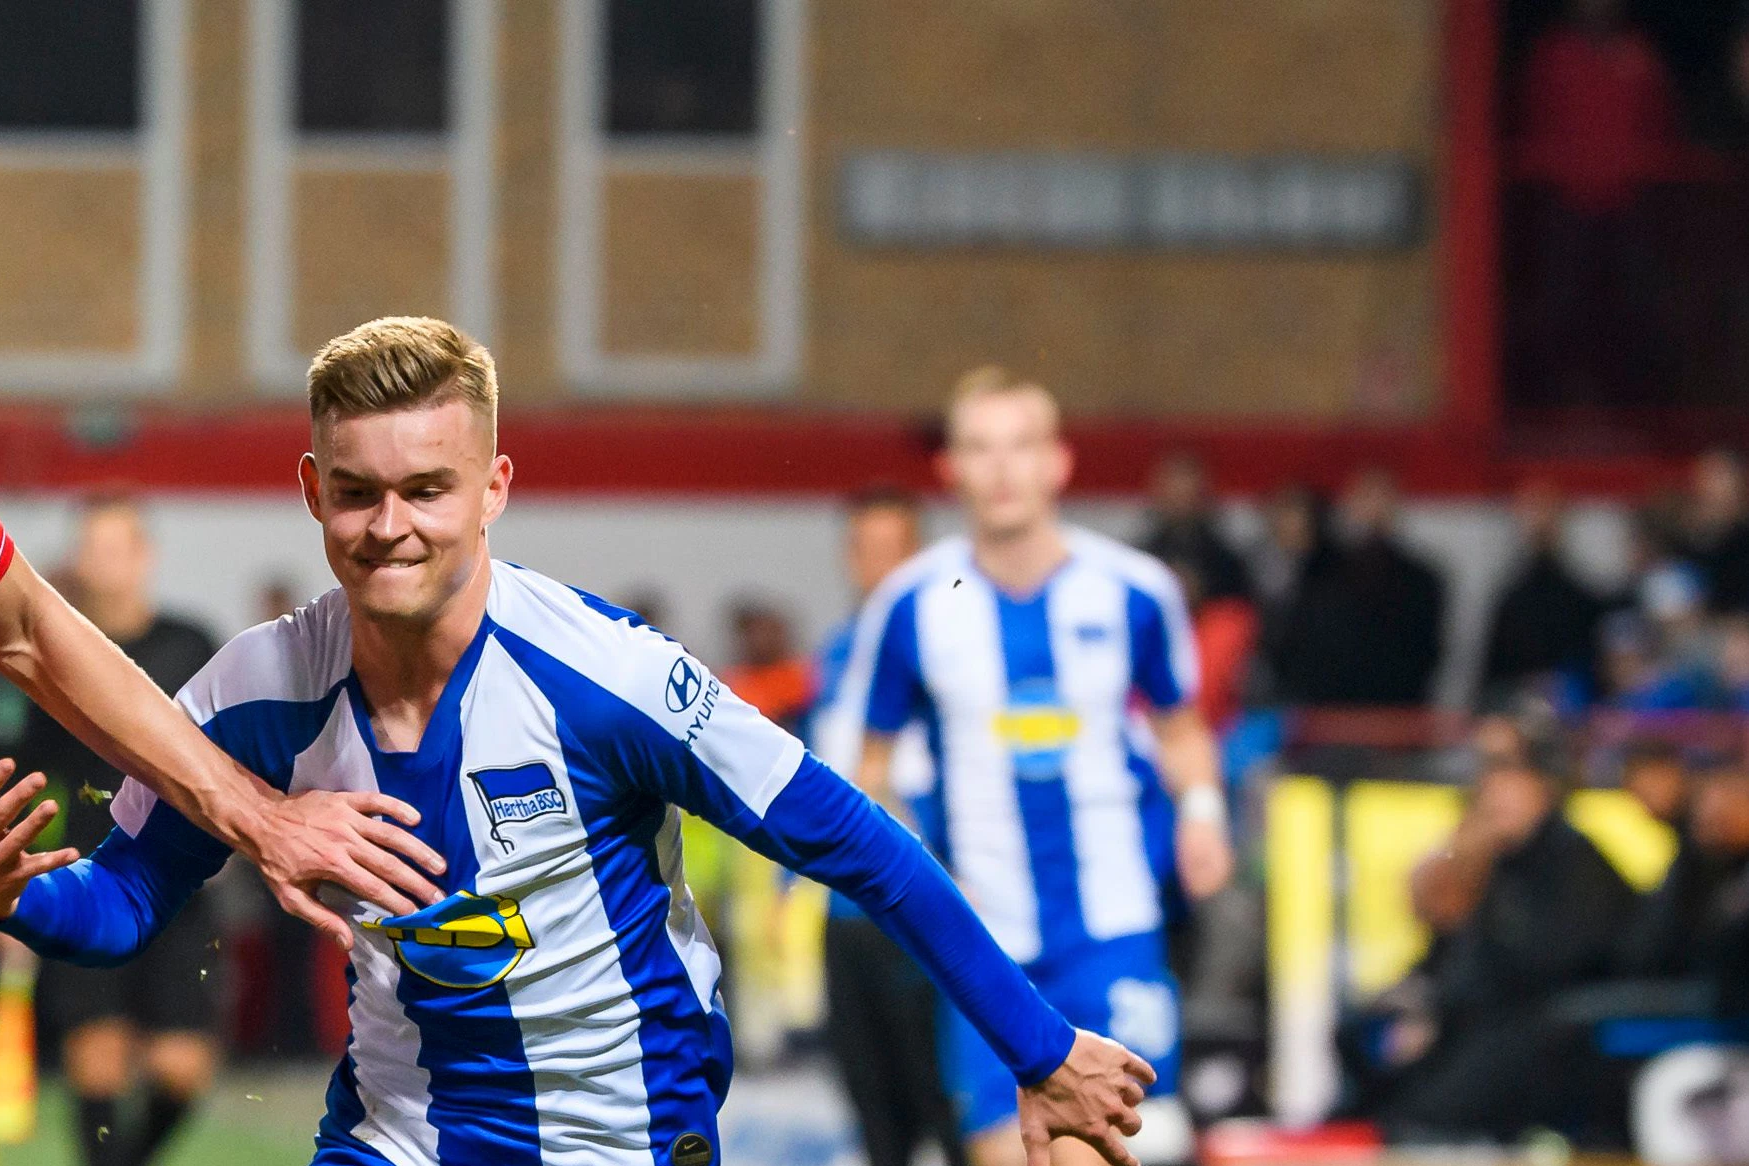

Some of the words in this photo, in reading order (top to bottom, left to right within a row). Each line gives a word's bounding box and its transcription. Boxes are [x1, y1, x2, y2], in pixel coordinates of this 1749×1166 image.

[680, 678, 720, 750] HYUND
[493, 798, 539, 819] Hertha
[535, 790, 562, 812] BSC
